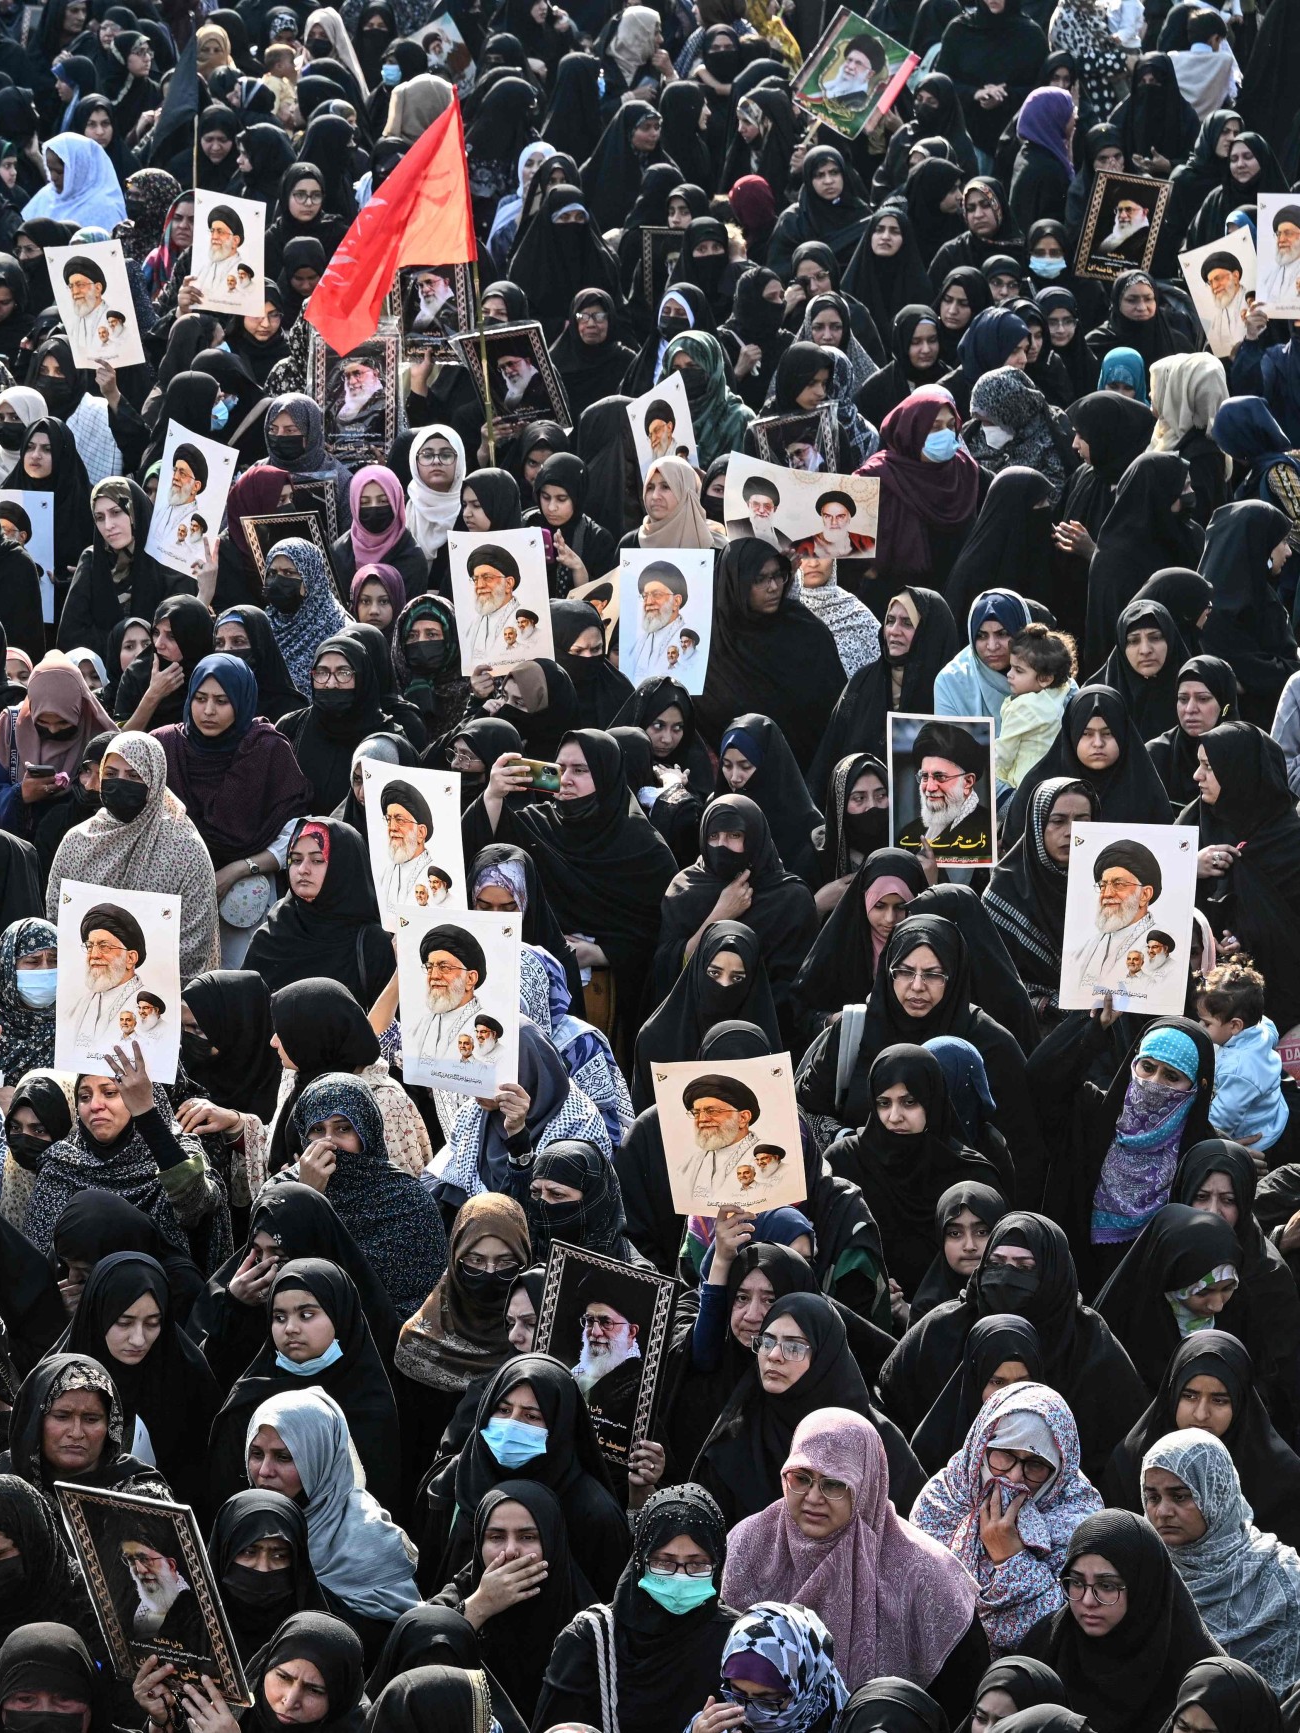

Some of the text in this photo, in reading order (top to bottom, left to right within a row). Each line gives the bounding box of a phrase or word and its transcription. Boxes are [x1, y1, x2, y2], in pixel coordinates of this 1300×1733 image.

[959, 832, 987, 849] ذلت
[590, 1405, 602, 1415] ولی
[171, 1641, 183, 1650] ولی
[180, 1666, 199, 1681] علی
